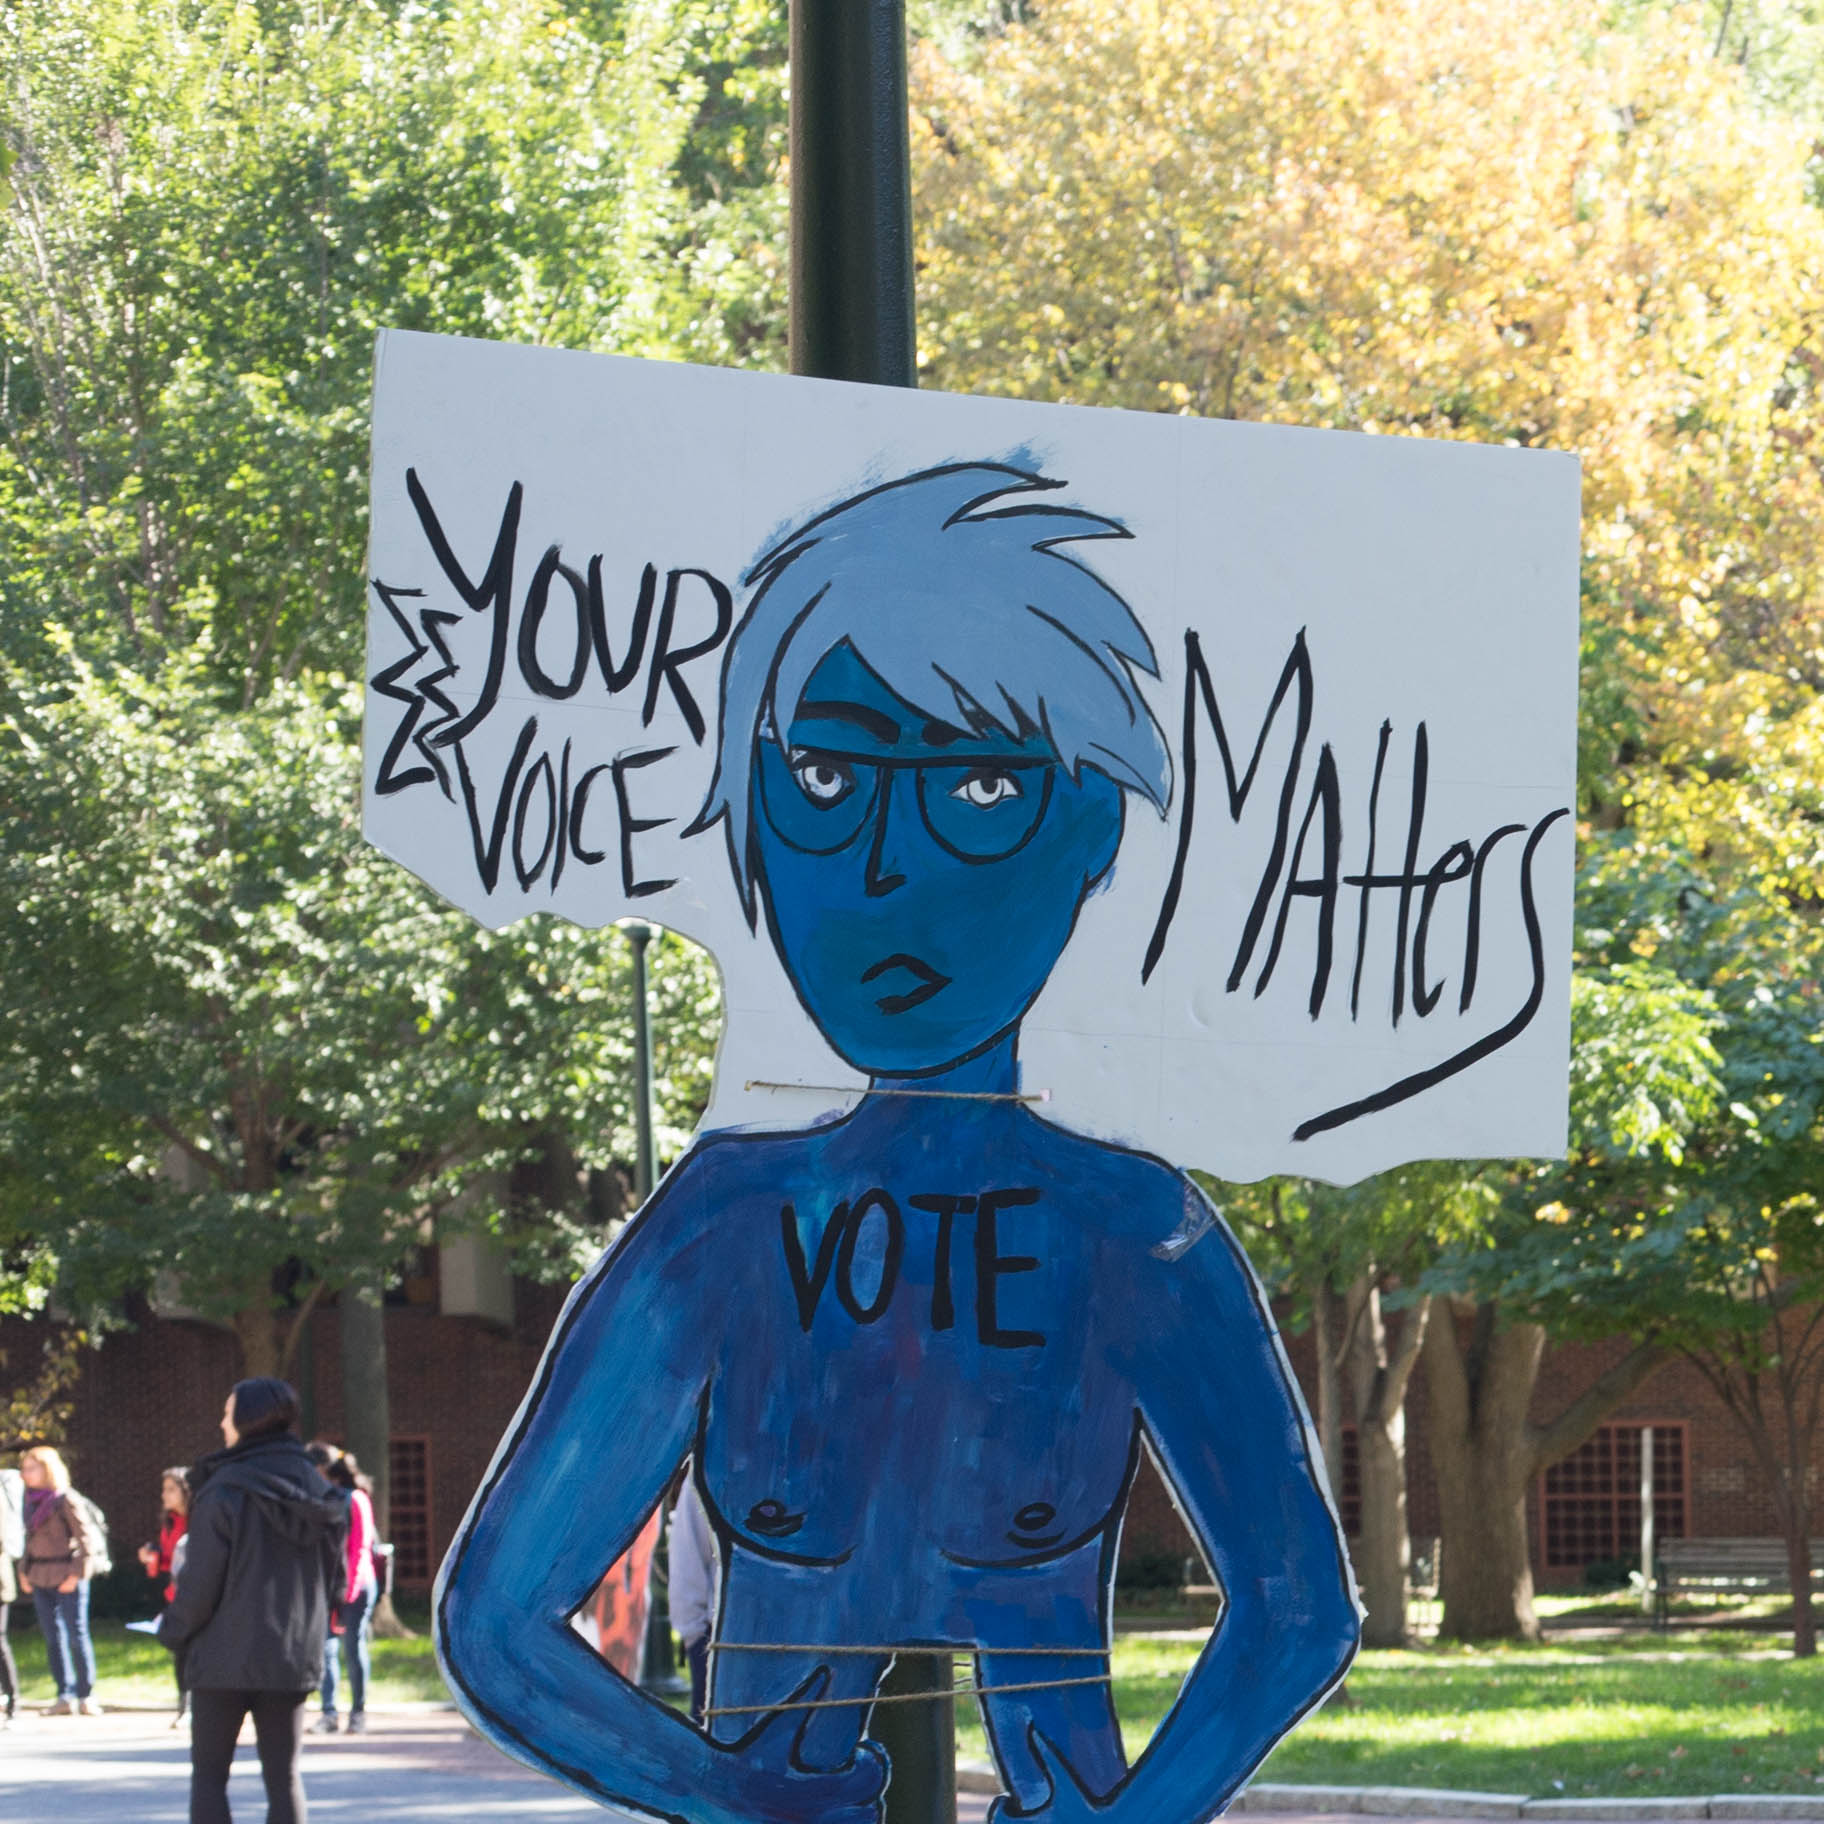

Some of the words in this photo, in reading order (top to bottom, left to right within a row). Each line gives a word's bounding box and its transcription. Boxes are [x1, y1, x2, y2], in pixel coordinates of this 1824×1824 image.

[405, 466, 734, 749] YOUR
[455, 713, 680, 899] VOICE
[780, 1187, 1046, 1350] VOTE
